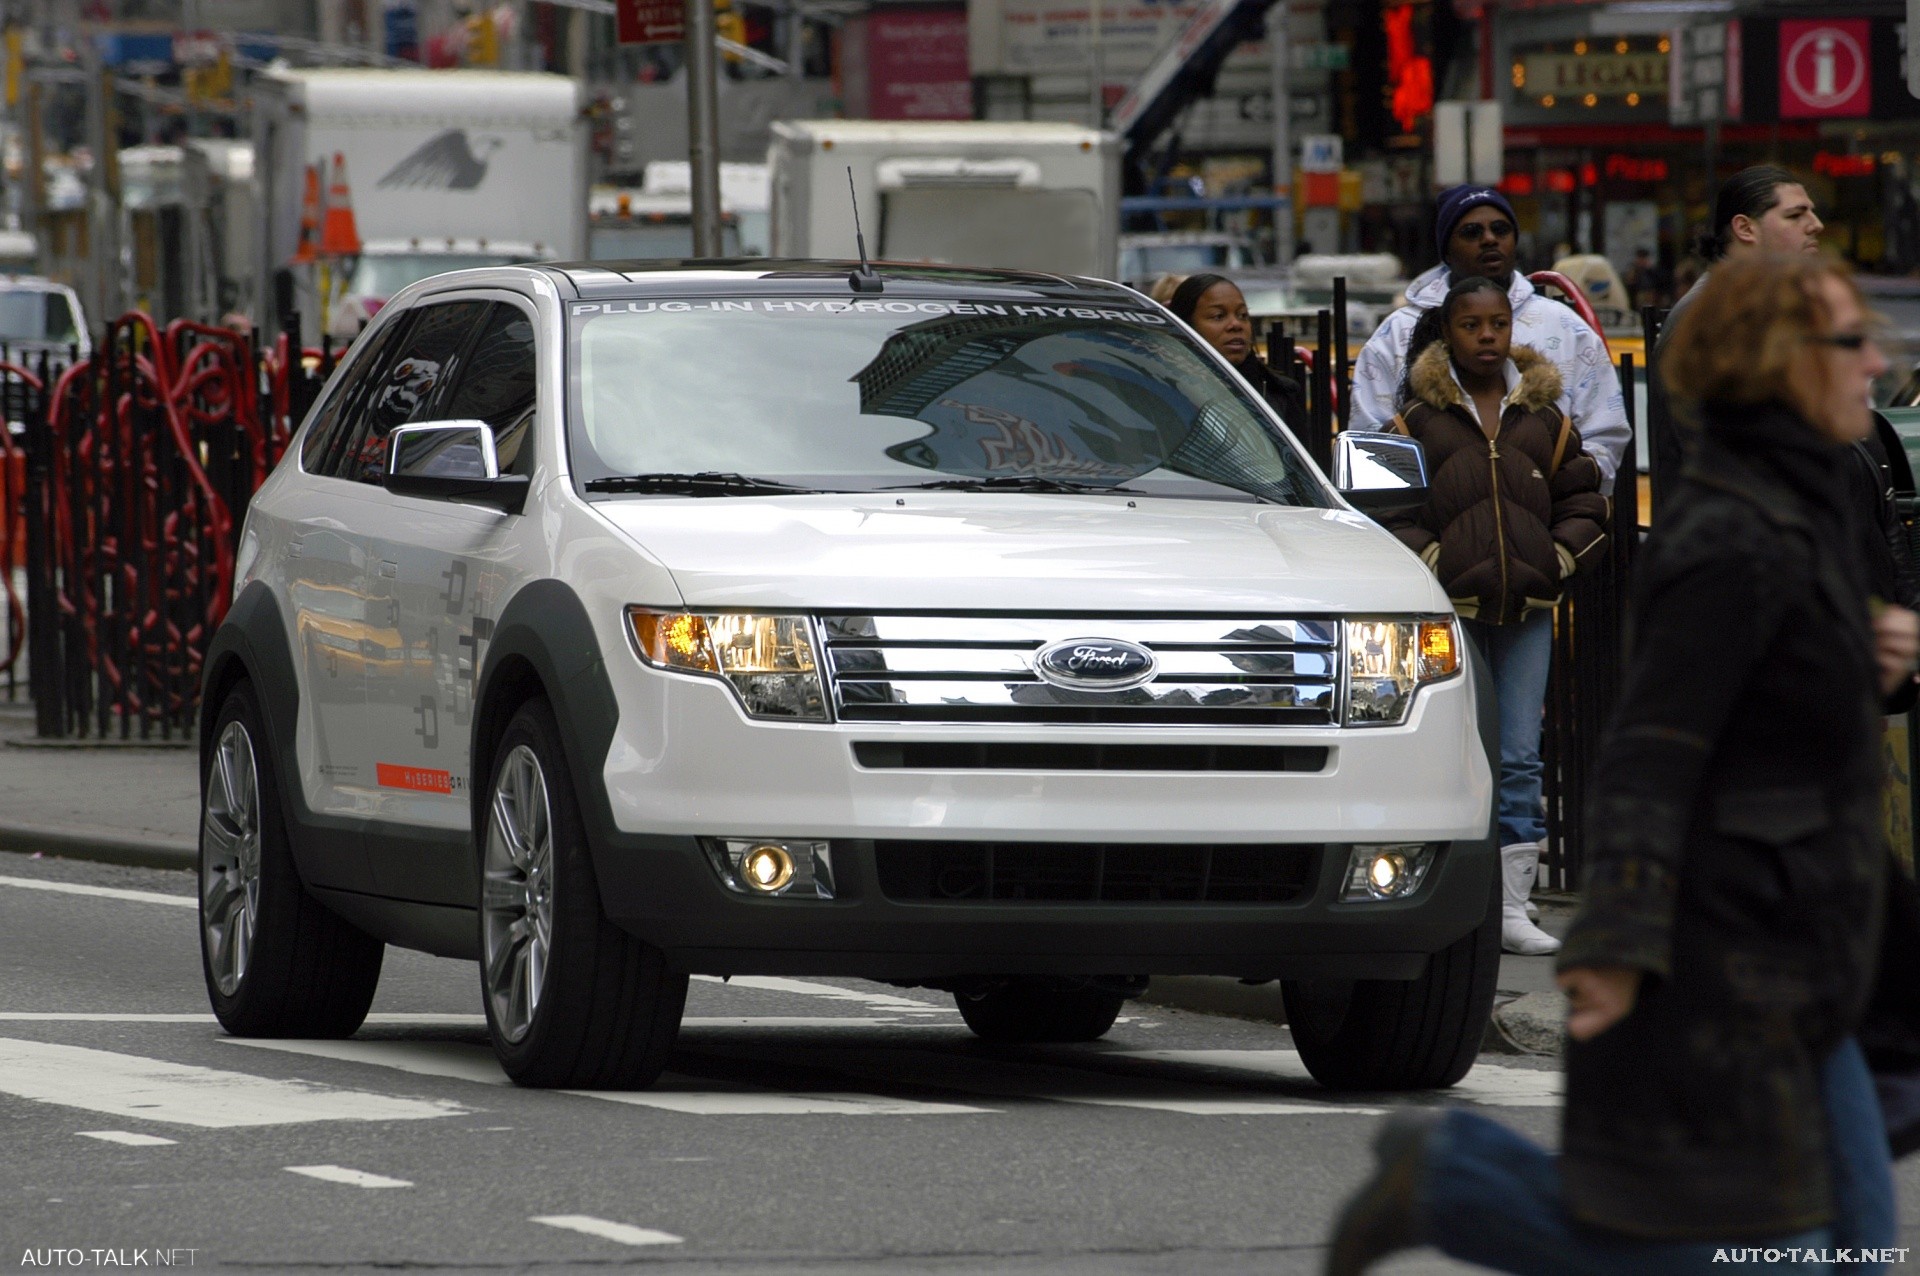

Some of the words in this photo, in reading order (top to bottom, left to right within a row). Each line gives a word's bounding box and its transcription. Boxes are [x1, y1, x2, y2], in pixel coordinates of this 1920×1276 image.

[572, 301, 754, 316] PLUG-IN
[765, 301, 1008, 317] HYDROGEN
[1015, 305, 1167, 325] HYBRID
[1067, 646, 1129, 670] Ford
